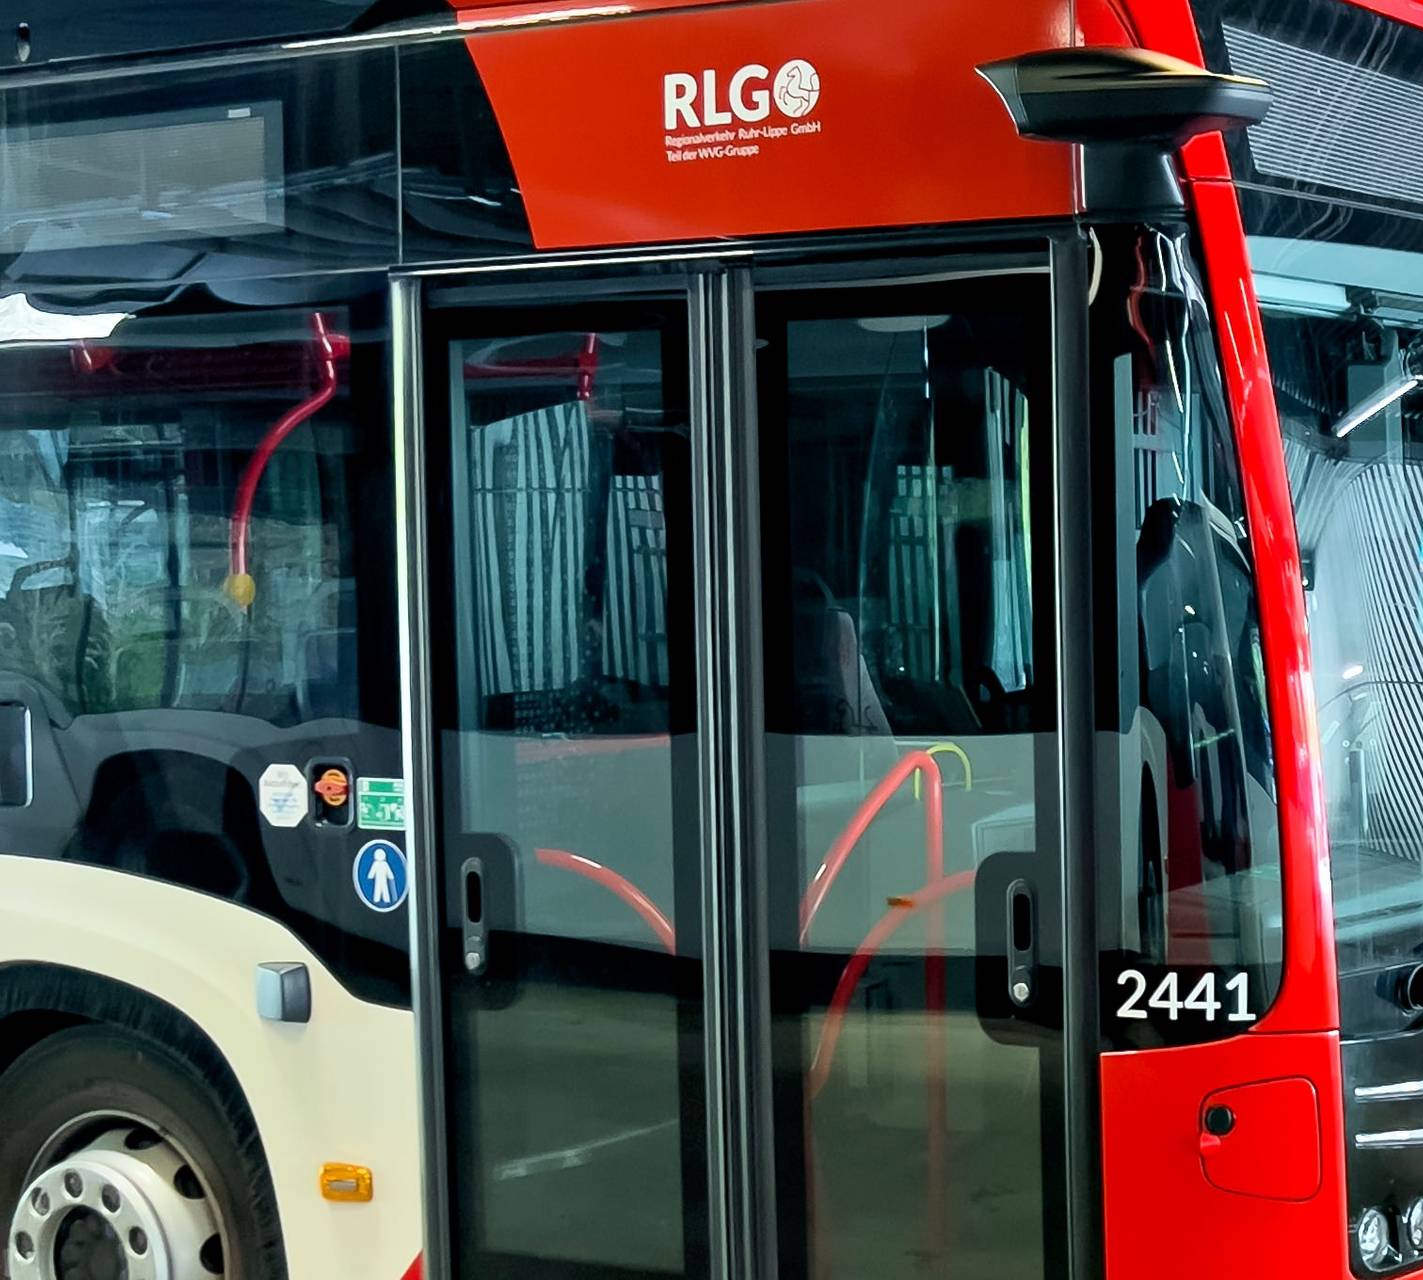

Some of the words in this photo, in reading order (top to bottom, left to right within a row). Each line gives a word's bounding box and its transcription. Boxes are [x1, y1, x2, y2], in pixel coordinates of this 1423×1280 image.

[664, 63, 770, 130] RLG
[665, 131, 735, 147] Regionalverkehr
[738, 125, 788, 140] Ruhr-Lippe
[790, 121, 821, 136] GmbH
[667, 149, 682, 162] Teil
[683, 149, 697, 161] der
[698, 145, 760, 160] WVG-Gruppe
[1116, 969, 1256, 1021] 2441
